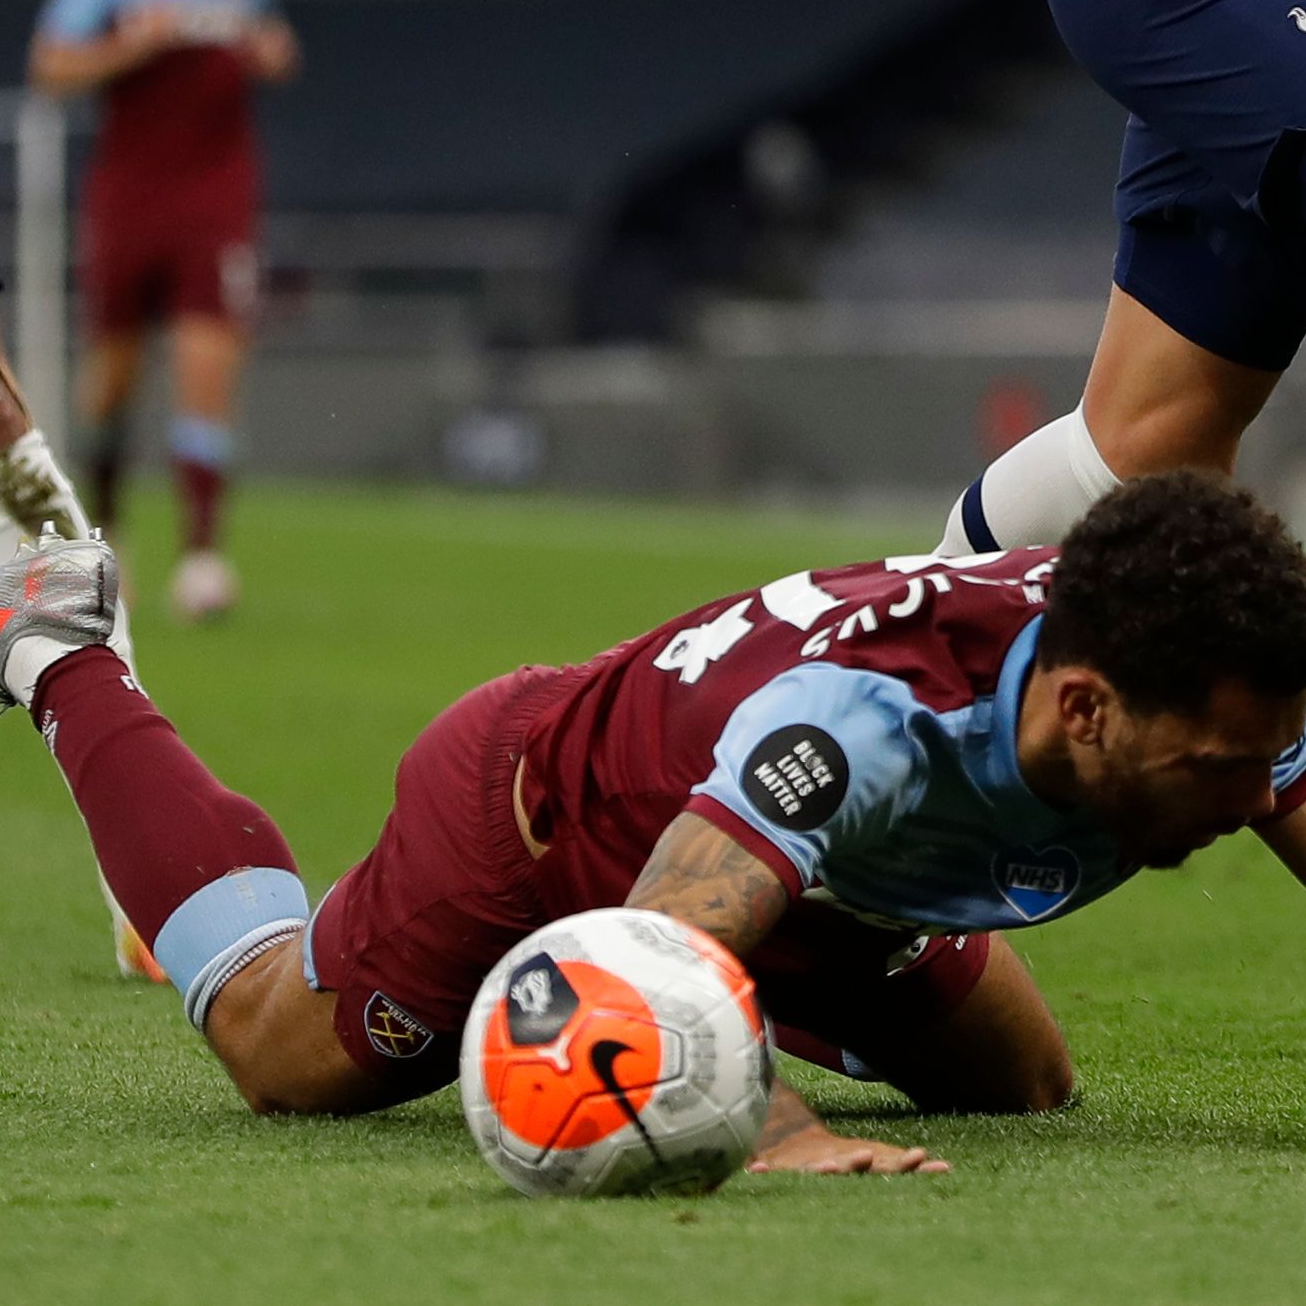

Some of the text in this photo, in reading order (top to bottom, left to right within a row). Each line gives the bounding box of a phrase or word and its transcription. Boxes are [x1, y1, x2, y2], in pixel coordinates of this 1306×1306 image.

[753, 761, 802, 816] MATTER
[776, 754, 816, 797] LIVES
[1008, 865, 1063, 890] NHS
